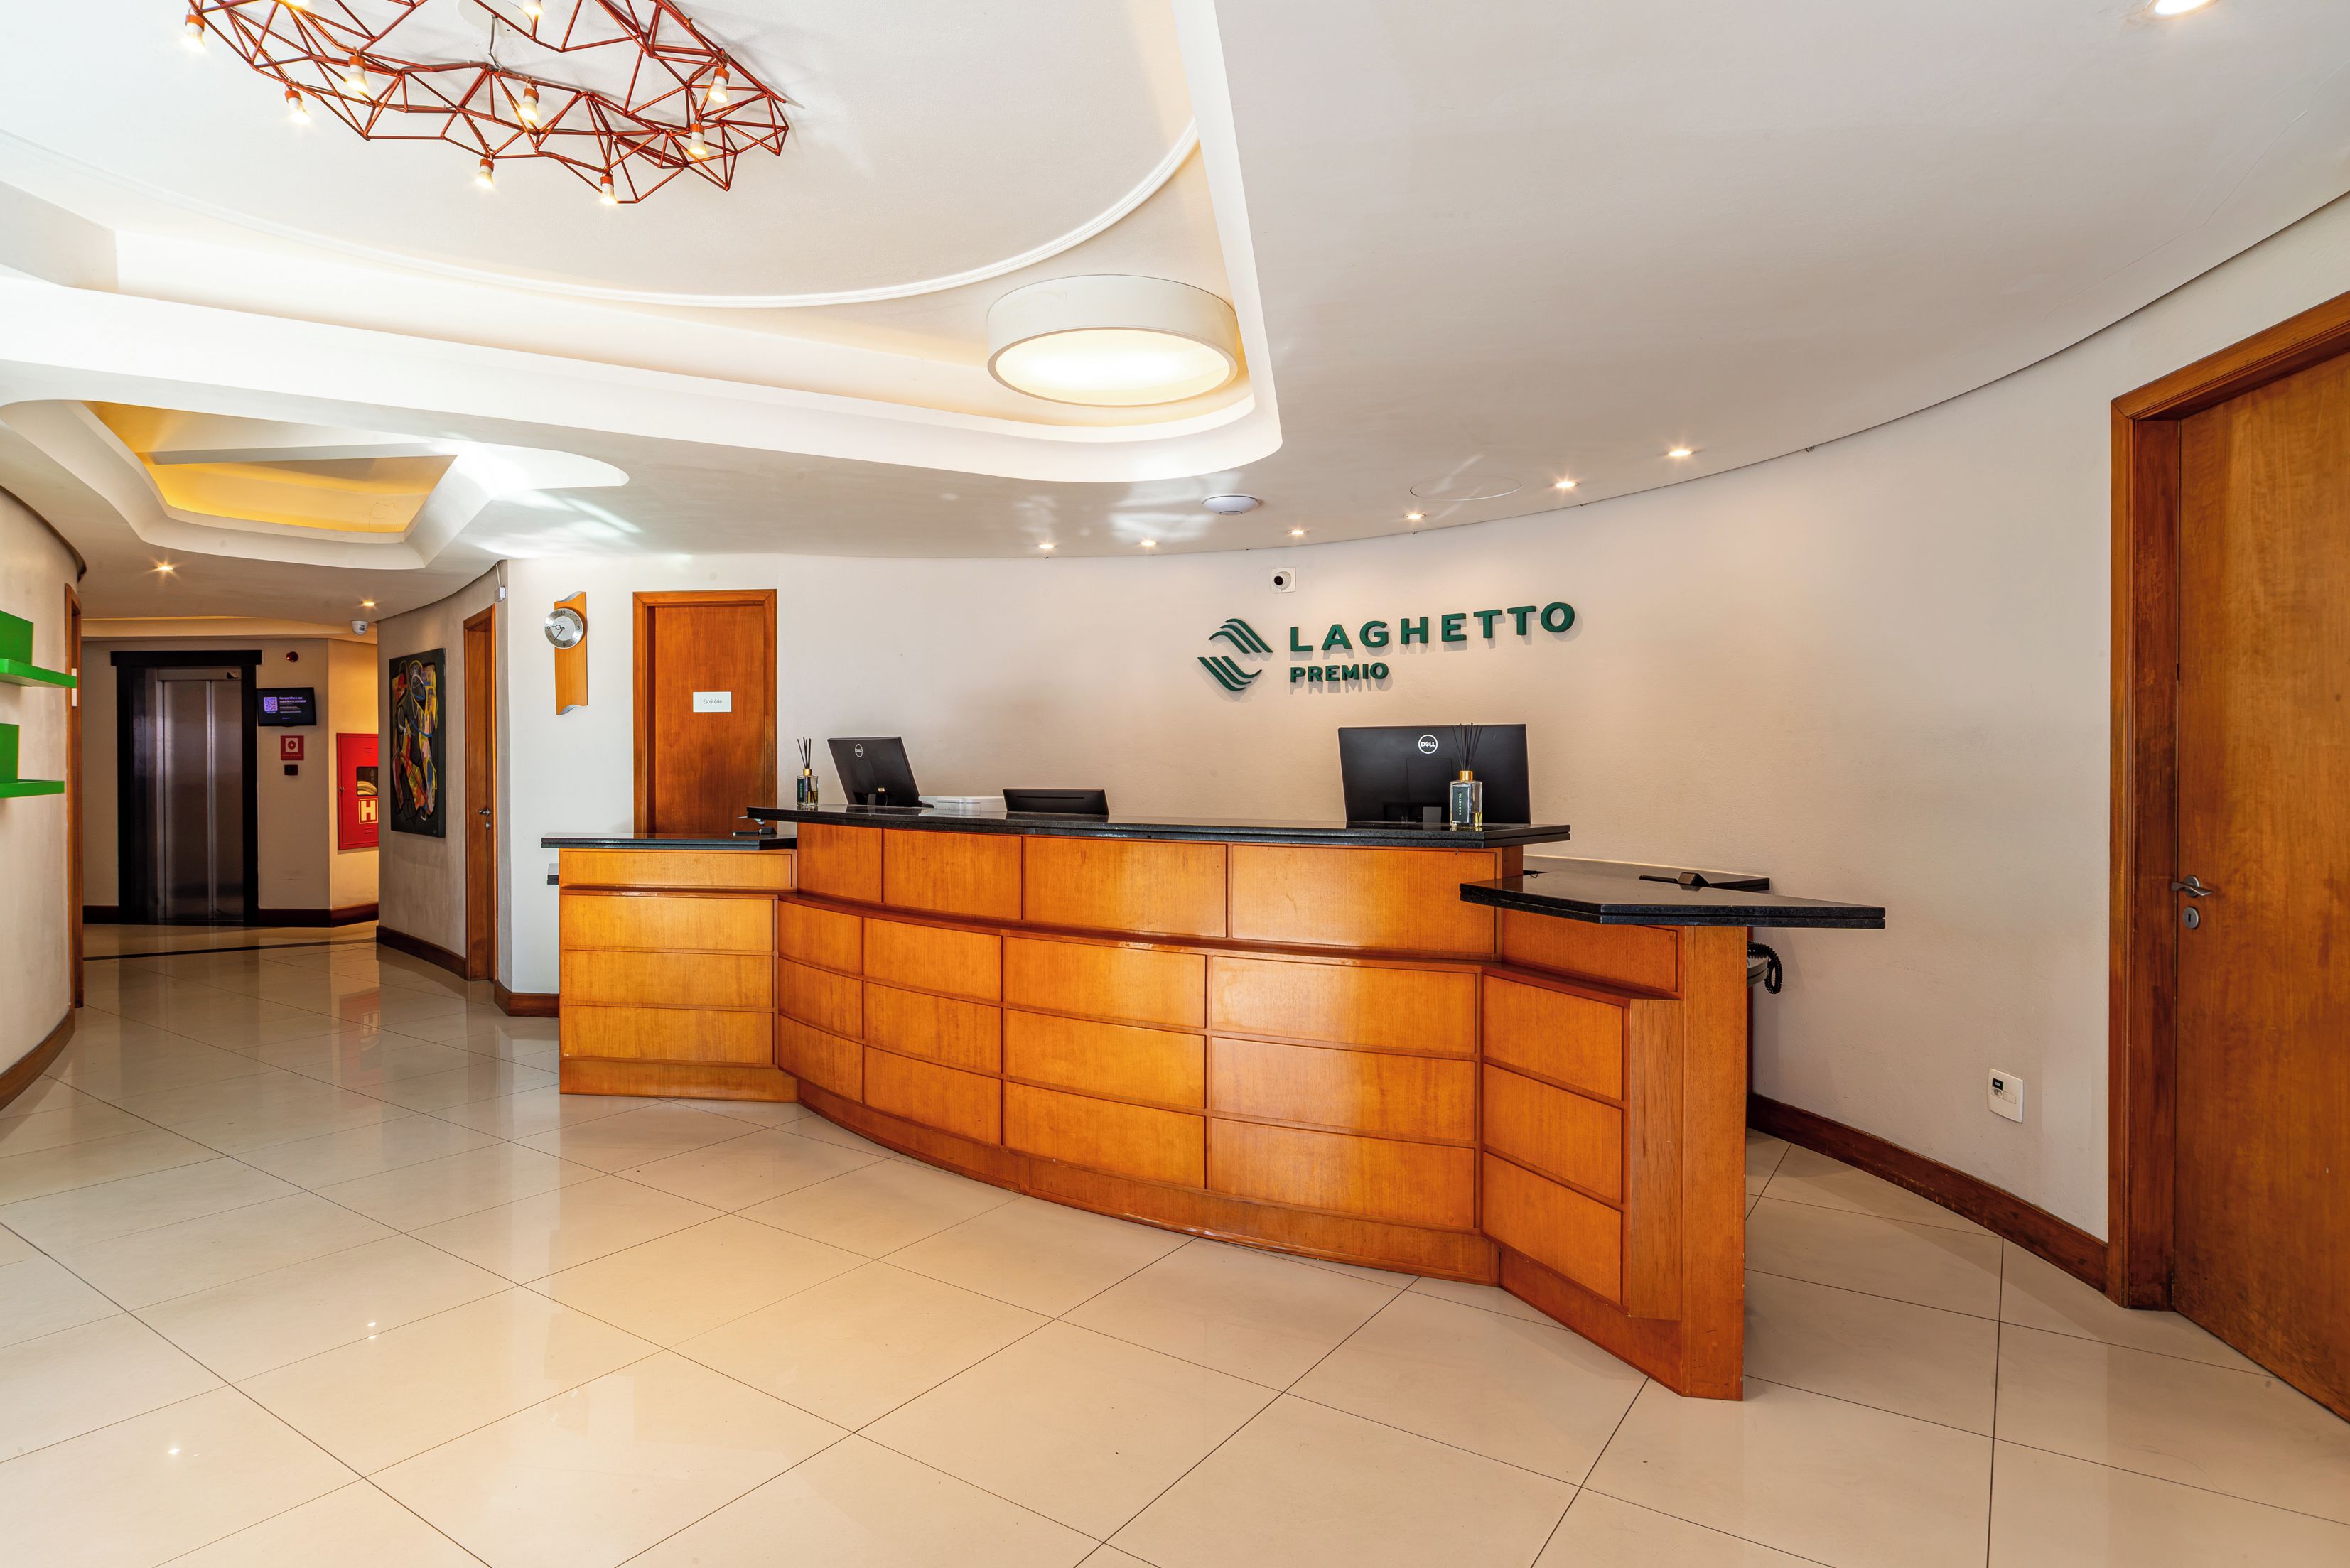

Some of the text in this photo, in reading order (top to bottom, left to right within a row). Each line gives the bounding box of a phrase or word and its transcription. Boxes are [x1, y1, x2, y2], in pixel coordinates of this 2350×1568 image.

[1290, 602, 1575, 652] LAGHETTO
[1290, 662, 1389, 683] PREMIO
[361, 800, 376, 821] H
